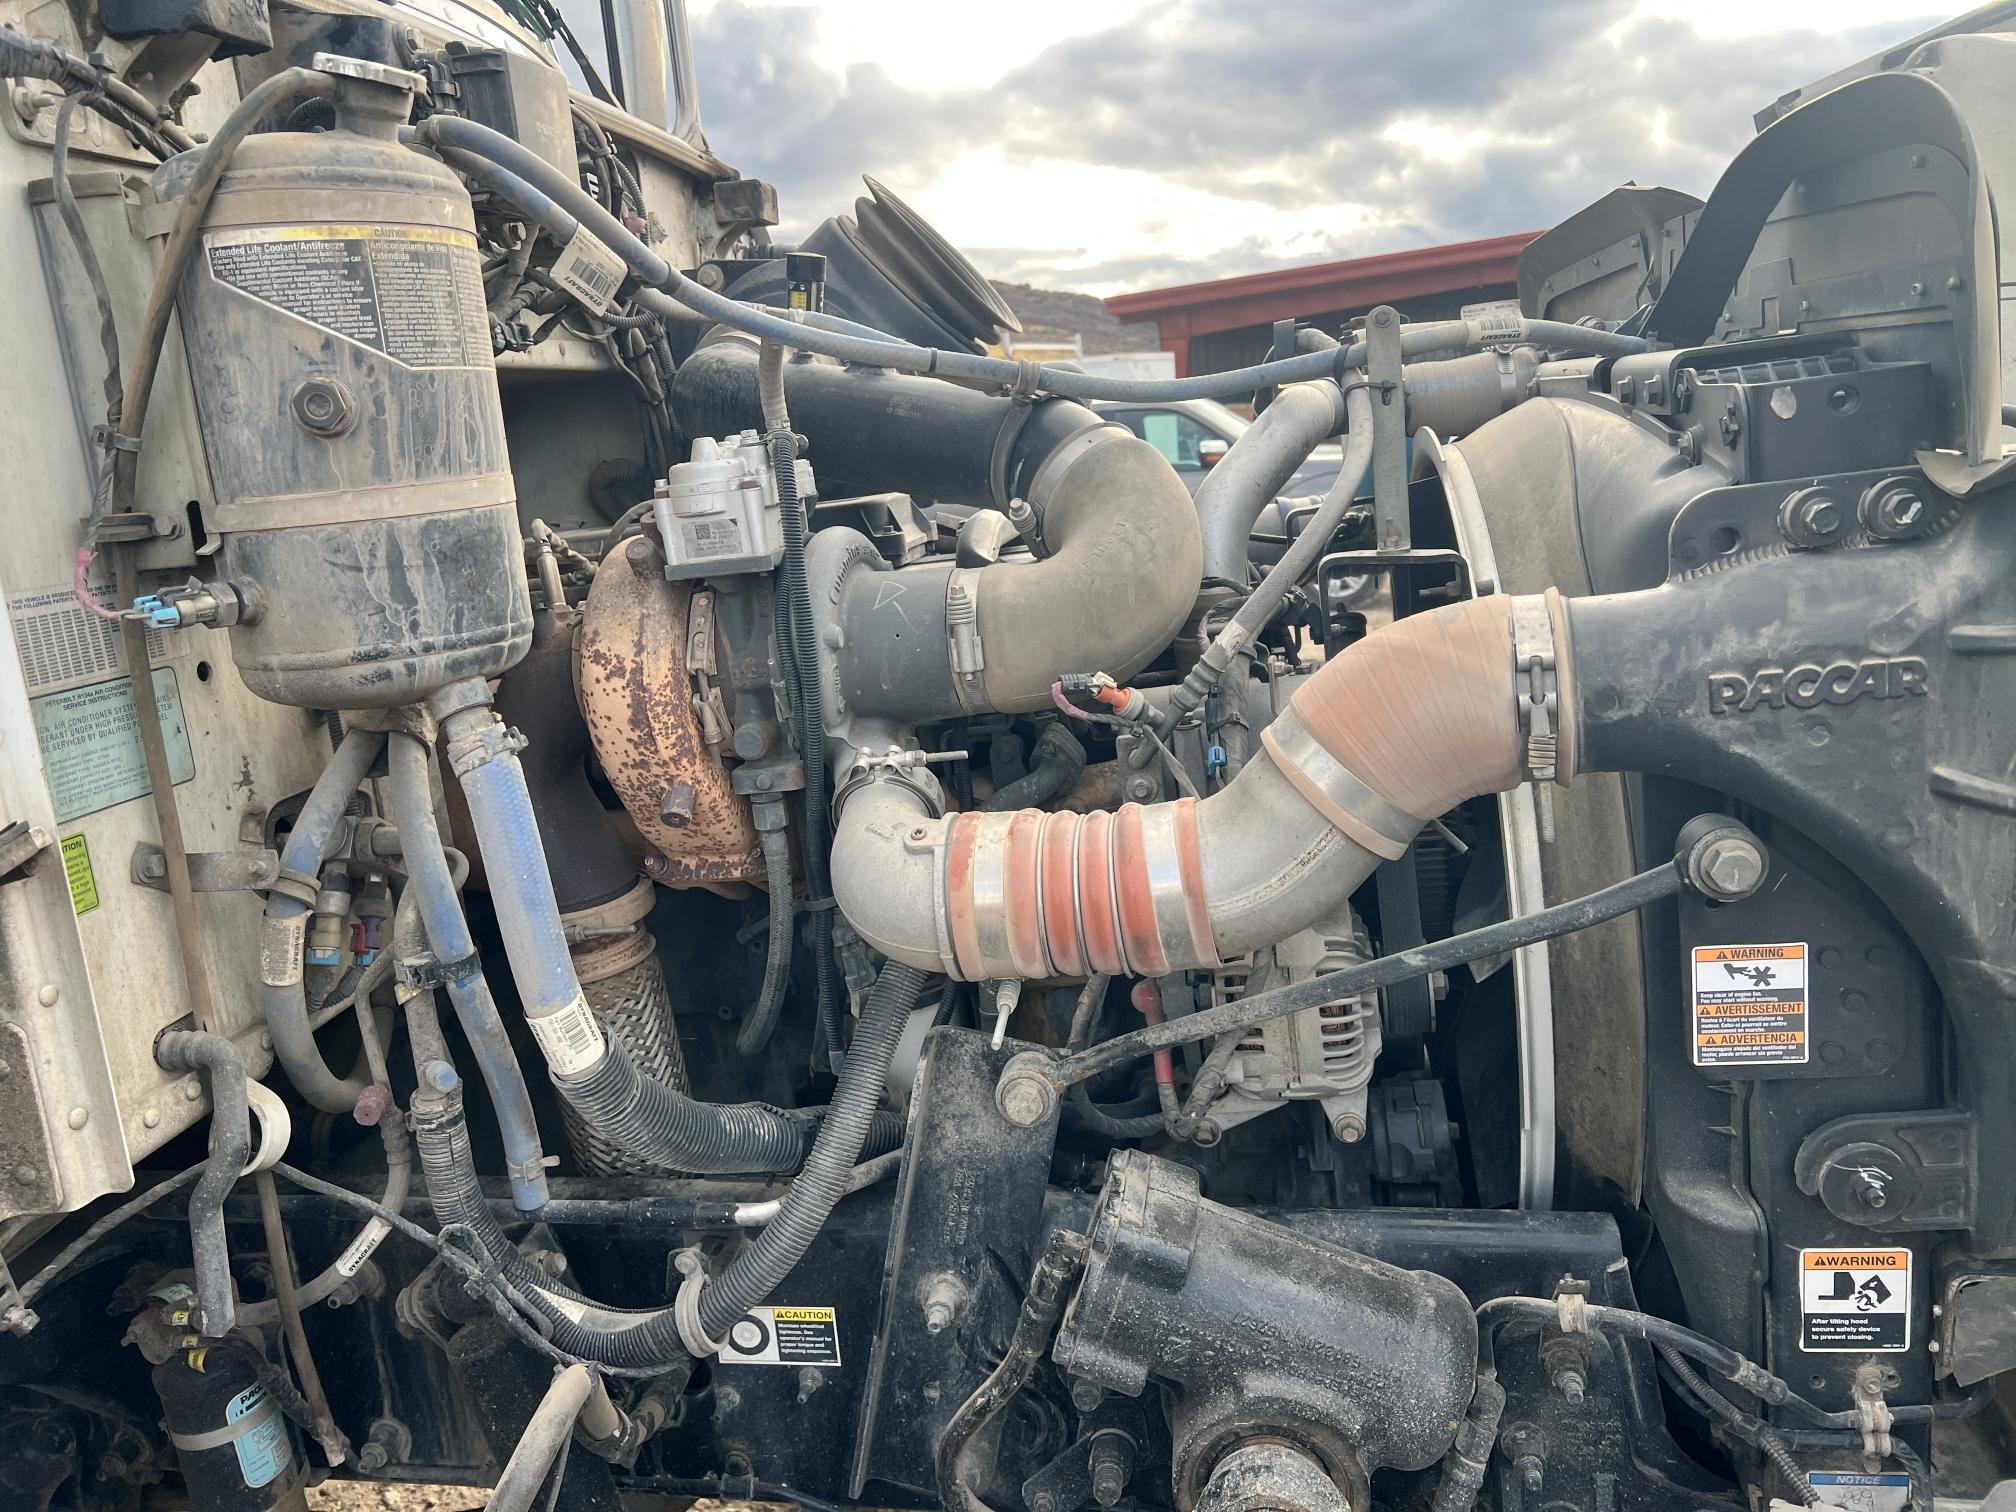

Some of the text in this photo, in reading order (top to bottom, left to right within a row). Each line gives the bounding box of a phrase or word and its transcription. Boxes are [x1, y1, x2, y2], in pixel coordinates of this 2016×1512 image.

[211, 241, 344, 257] Extended Life Coolant/Antifreeze
[269, 270, 305, 278] conventional
[564, 276, 603, 306] DYNACRAFT
[1480, 332, 1521, 341] DYNACRAFT
[24, 601, 52, 609] FOLLOWING
[1708, 655, 1929, 714] PACCAR
[45, 696, 75, 707] PETERBILT
[63, 691, 128, 711] SERVICE INSTRUCTIONS
[54, 722, 65, 731] AIR
[68, 709, 112, 728] CONDITIONER
[70, 724, 94, 736] UNDER
[95, 720, 111, 729] HIGH
[52, 738, 86, 752] SERVICED
[88, 733, 96, 741] BY
[99, 723, 131, 738] QUALIFIED
[63, 841, 82, 854] TION
[292, 925, 301, 970] DYNACRAFT
[1731, 949, 1784, 959] WARNING
[1715, 1003, 1802, 1014] AVERTISSEMENT
[578, 1003, 599, 1042] DYNACRAFT
[1720, 1033, 1797, 1044] ADVERTENCIA
[348, 1238, 377, 1272] DYNACRAFT
[1827, 1257, 1896, 1265] WARNING
[785, 1311, 831, 1319] CAUTION
[1836, 1475, 1881, 1485] NOTICE
